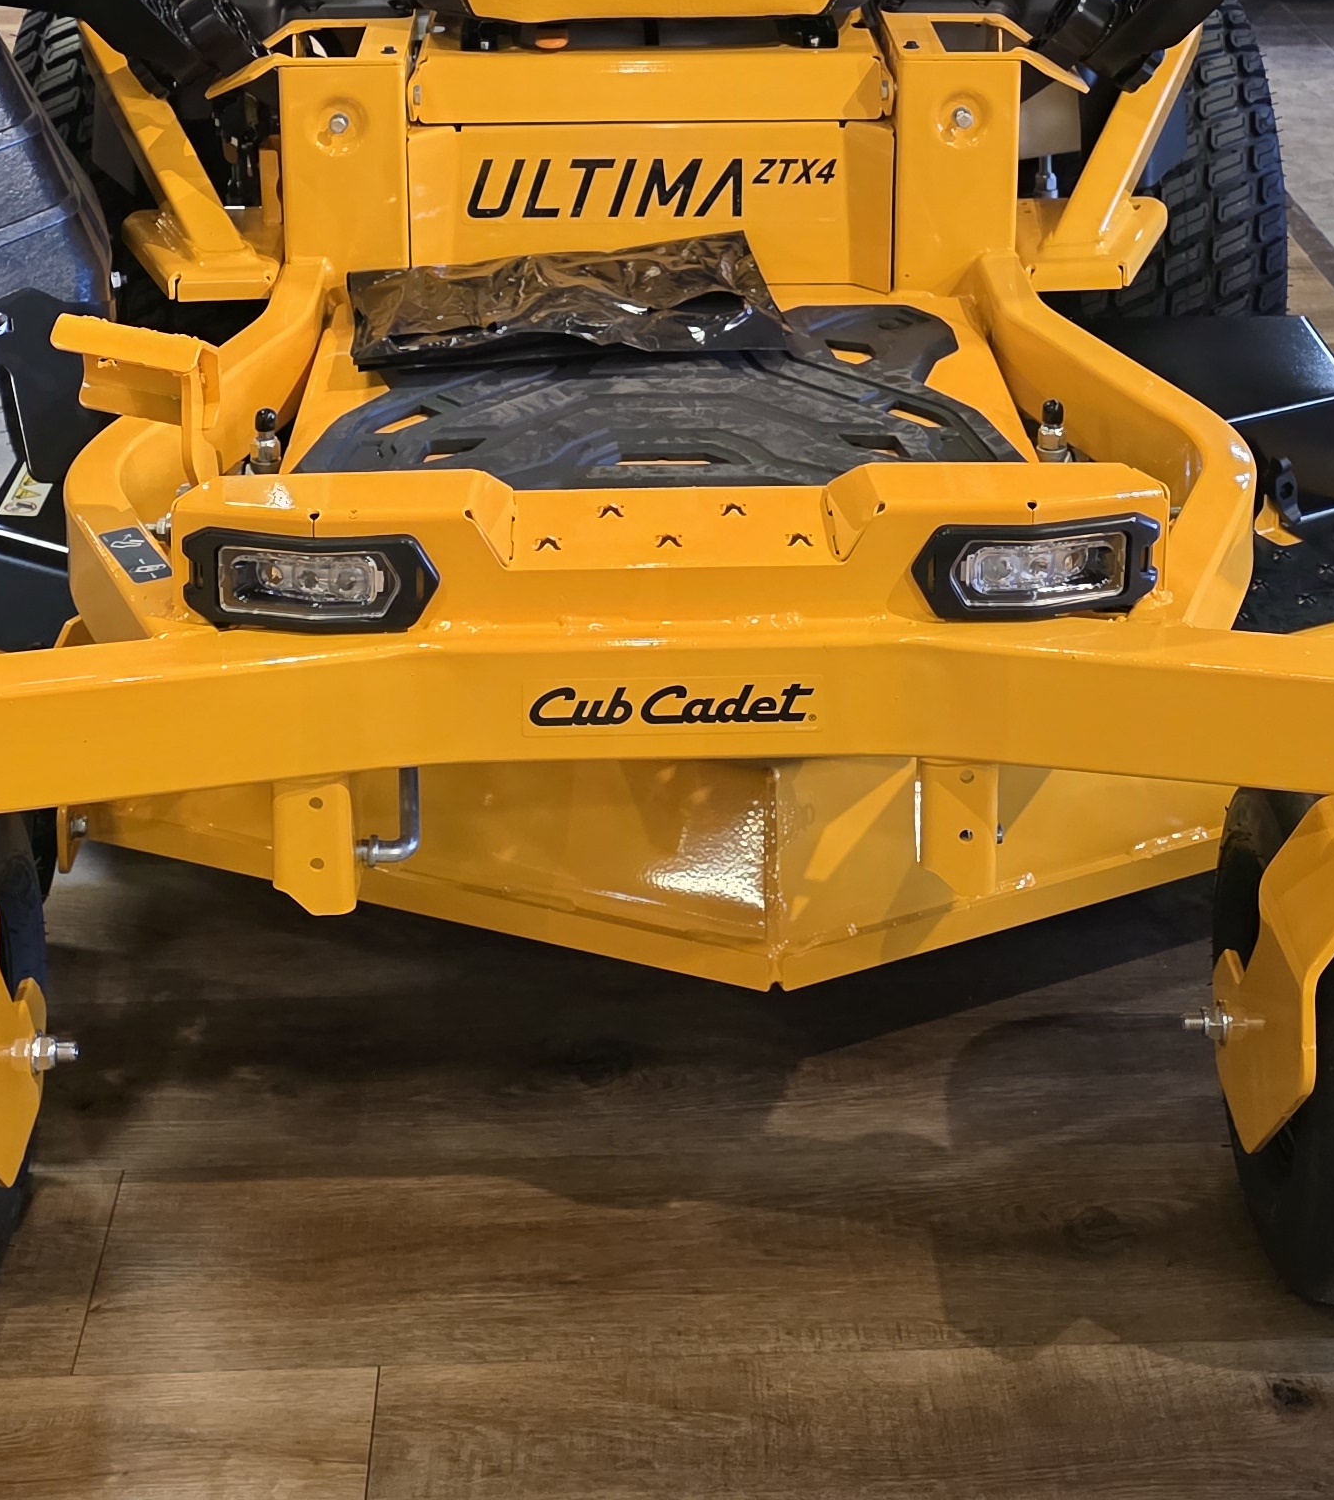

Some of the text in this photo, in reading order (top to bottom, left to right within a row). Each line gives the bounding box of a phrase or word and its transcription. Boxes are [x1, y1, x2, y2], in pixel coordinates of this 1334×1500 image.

[467, 158, 837, 218] ULTIMA ZTX4
[529, 683, 815, 726] Cub Cadet
